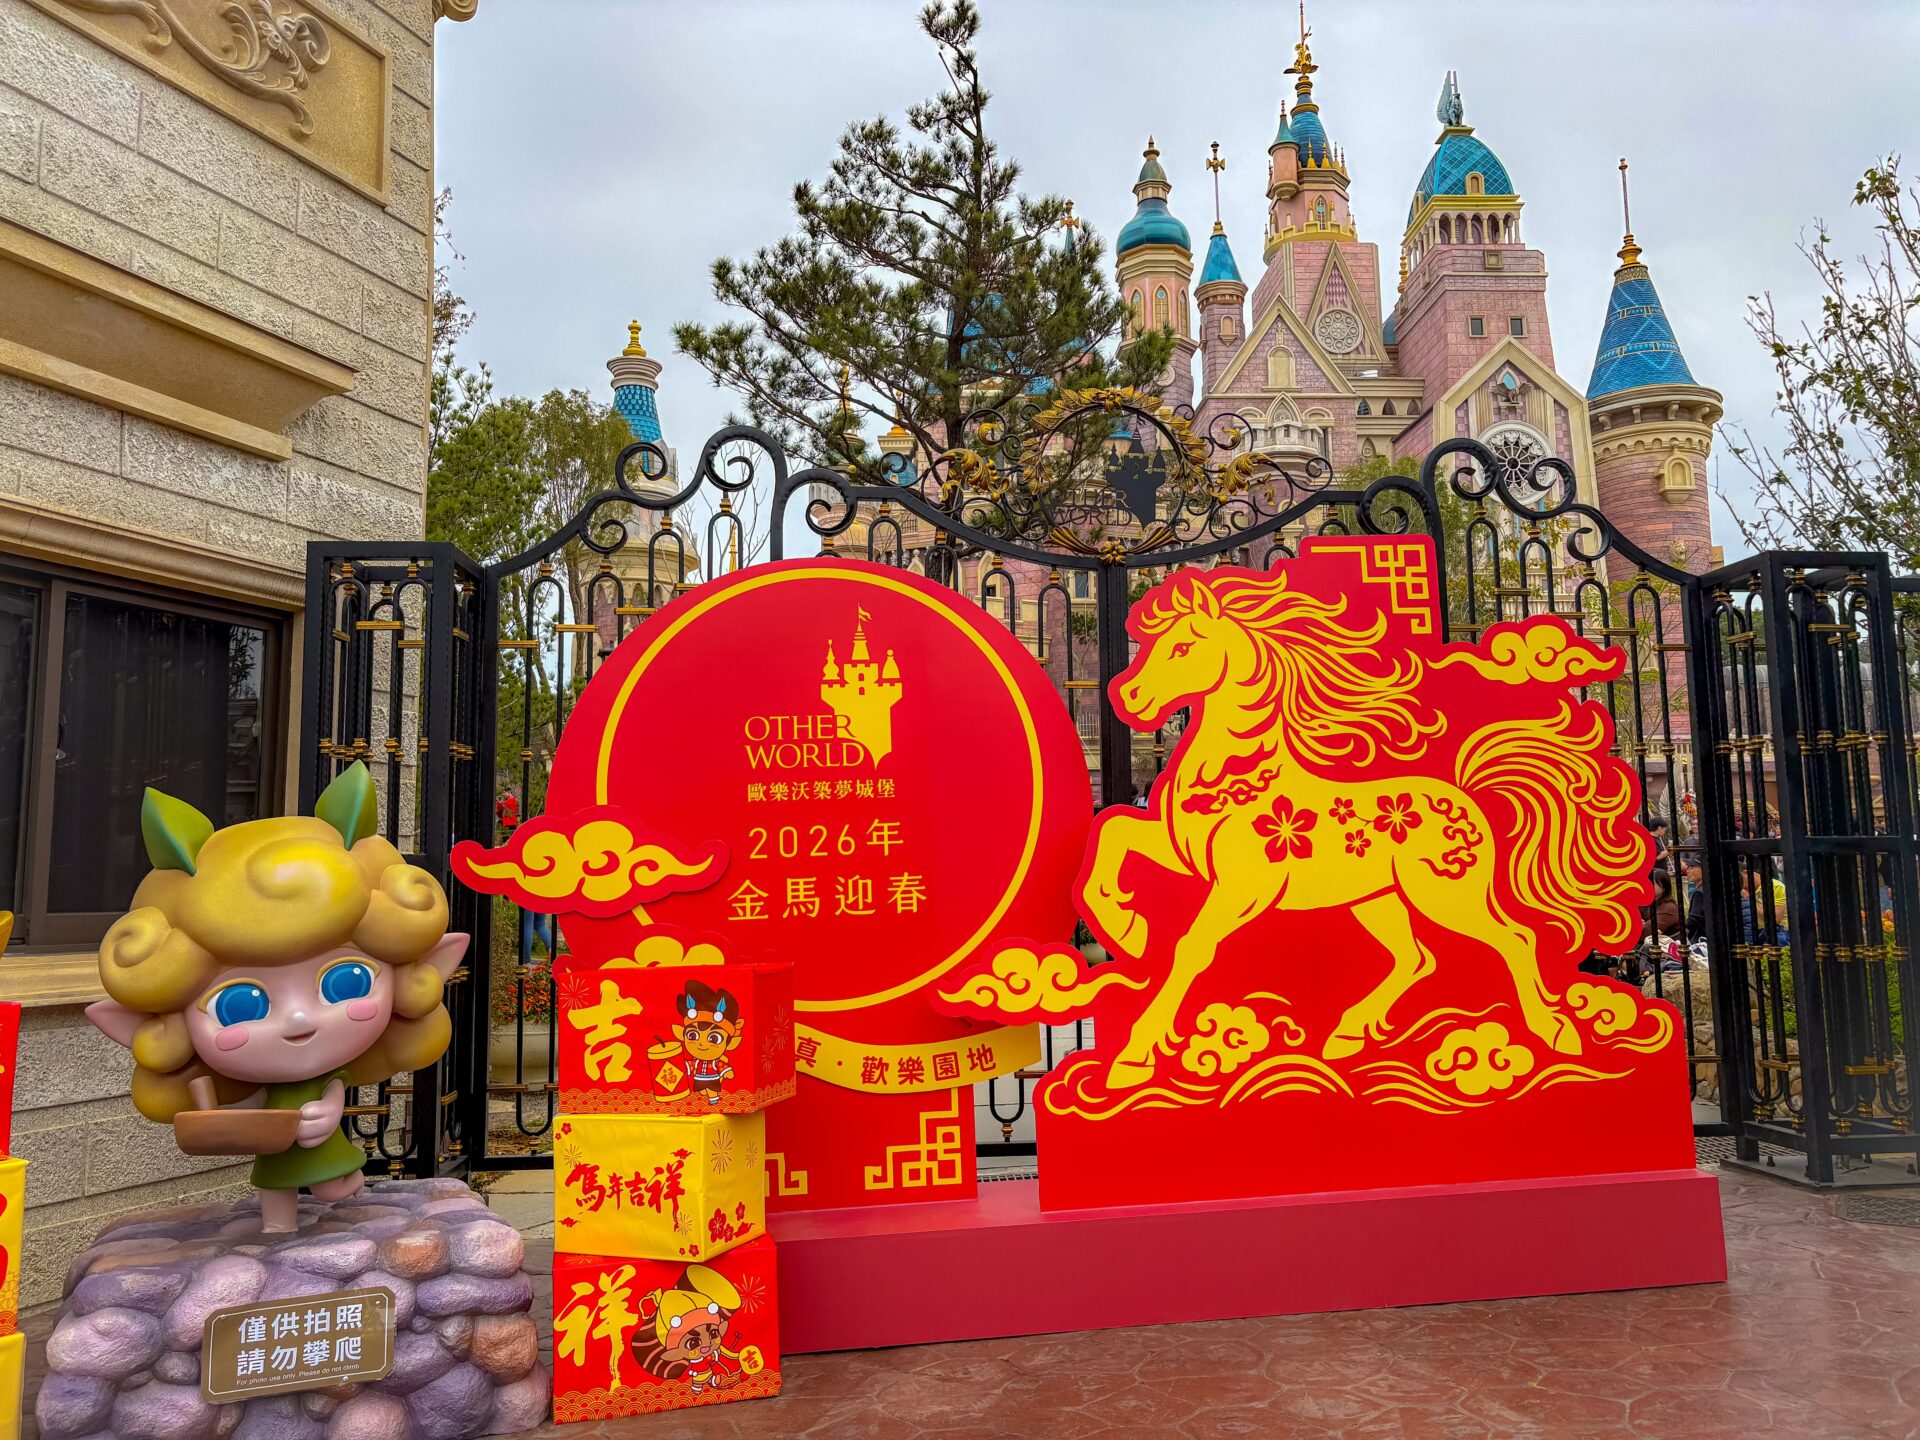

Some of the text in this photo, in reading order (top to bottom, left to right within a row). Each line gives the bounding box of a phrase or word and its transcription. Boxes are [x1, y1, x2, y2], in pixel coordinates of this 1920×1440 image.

[1050, 506, 1133, 527] WORLD
[745, 714, 856, 741] OTHER
[744, 743, 865, 769] WORLD
[747, 778, 896, 803] 歐樂沃築夢城堡
[749, 818, 904, 859] 2026年
[727, 871, 928, 921] 金馬迎春
[567, 979, 643, 1083] 吉
[660, 1066, 678, 1086] 福
[238, 1303, 363, 1344] 僅供拍照
[554, 1264, 639, 1395] 祥
[236, 1336, 362, 1377] 請勿攀爬
[249, 1376, 268, 1385] photo
[268, 1374, 281, 1382] use
[298, 1369, 321, 1377] Please
[331, 1365, 342, 1373] not
[342, 1363, 360, 1371] climb
